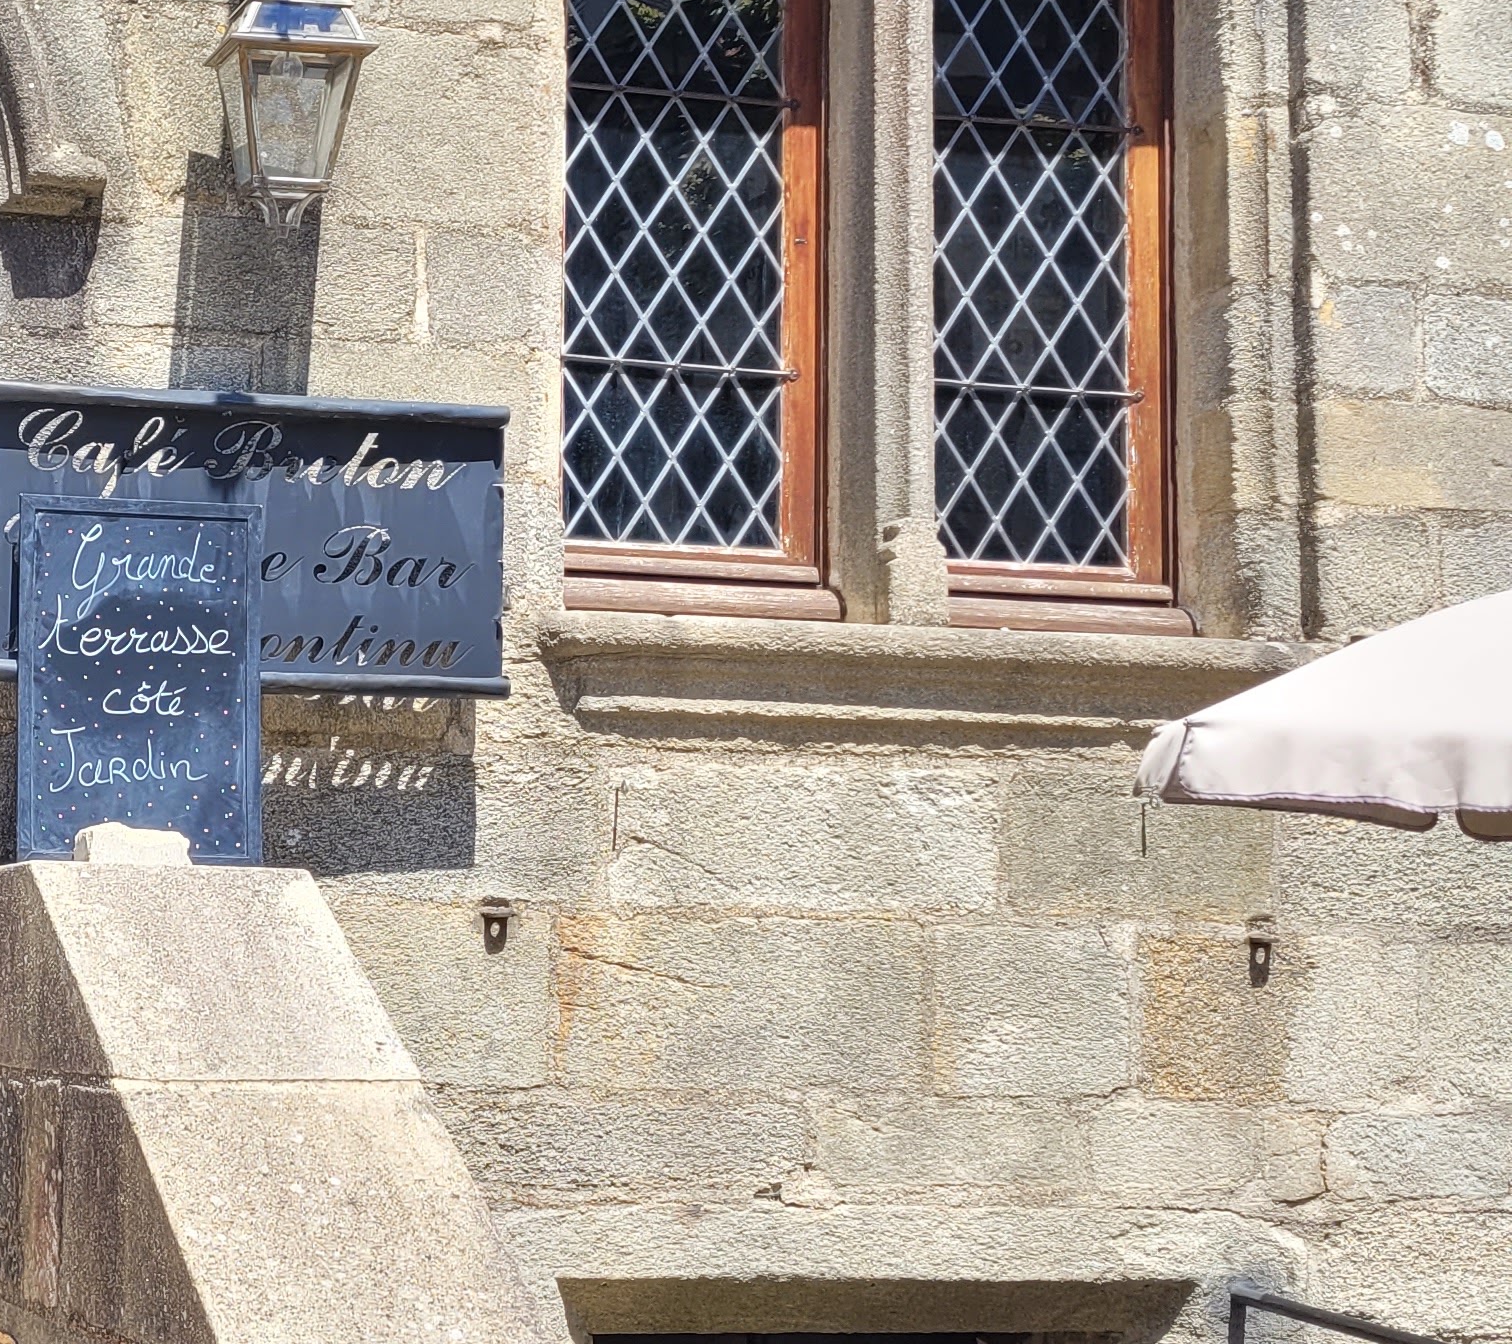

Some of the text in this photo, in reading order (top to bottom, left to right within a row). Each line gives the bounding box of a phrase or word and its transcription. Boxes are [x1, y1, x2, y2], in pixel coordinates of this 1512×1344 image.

[18, 408, 467, 500] Café Breton
[71, 523, 217, 621] Grande
[312, 525, 477, 589] Bar
[259, 613, 475, 670] ontinu
[102, 680, 187, 716] côté
